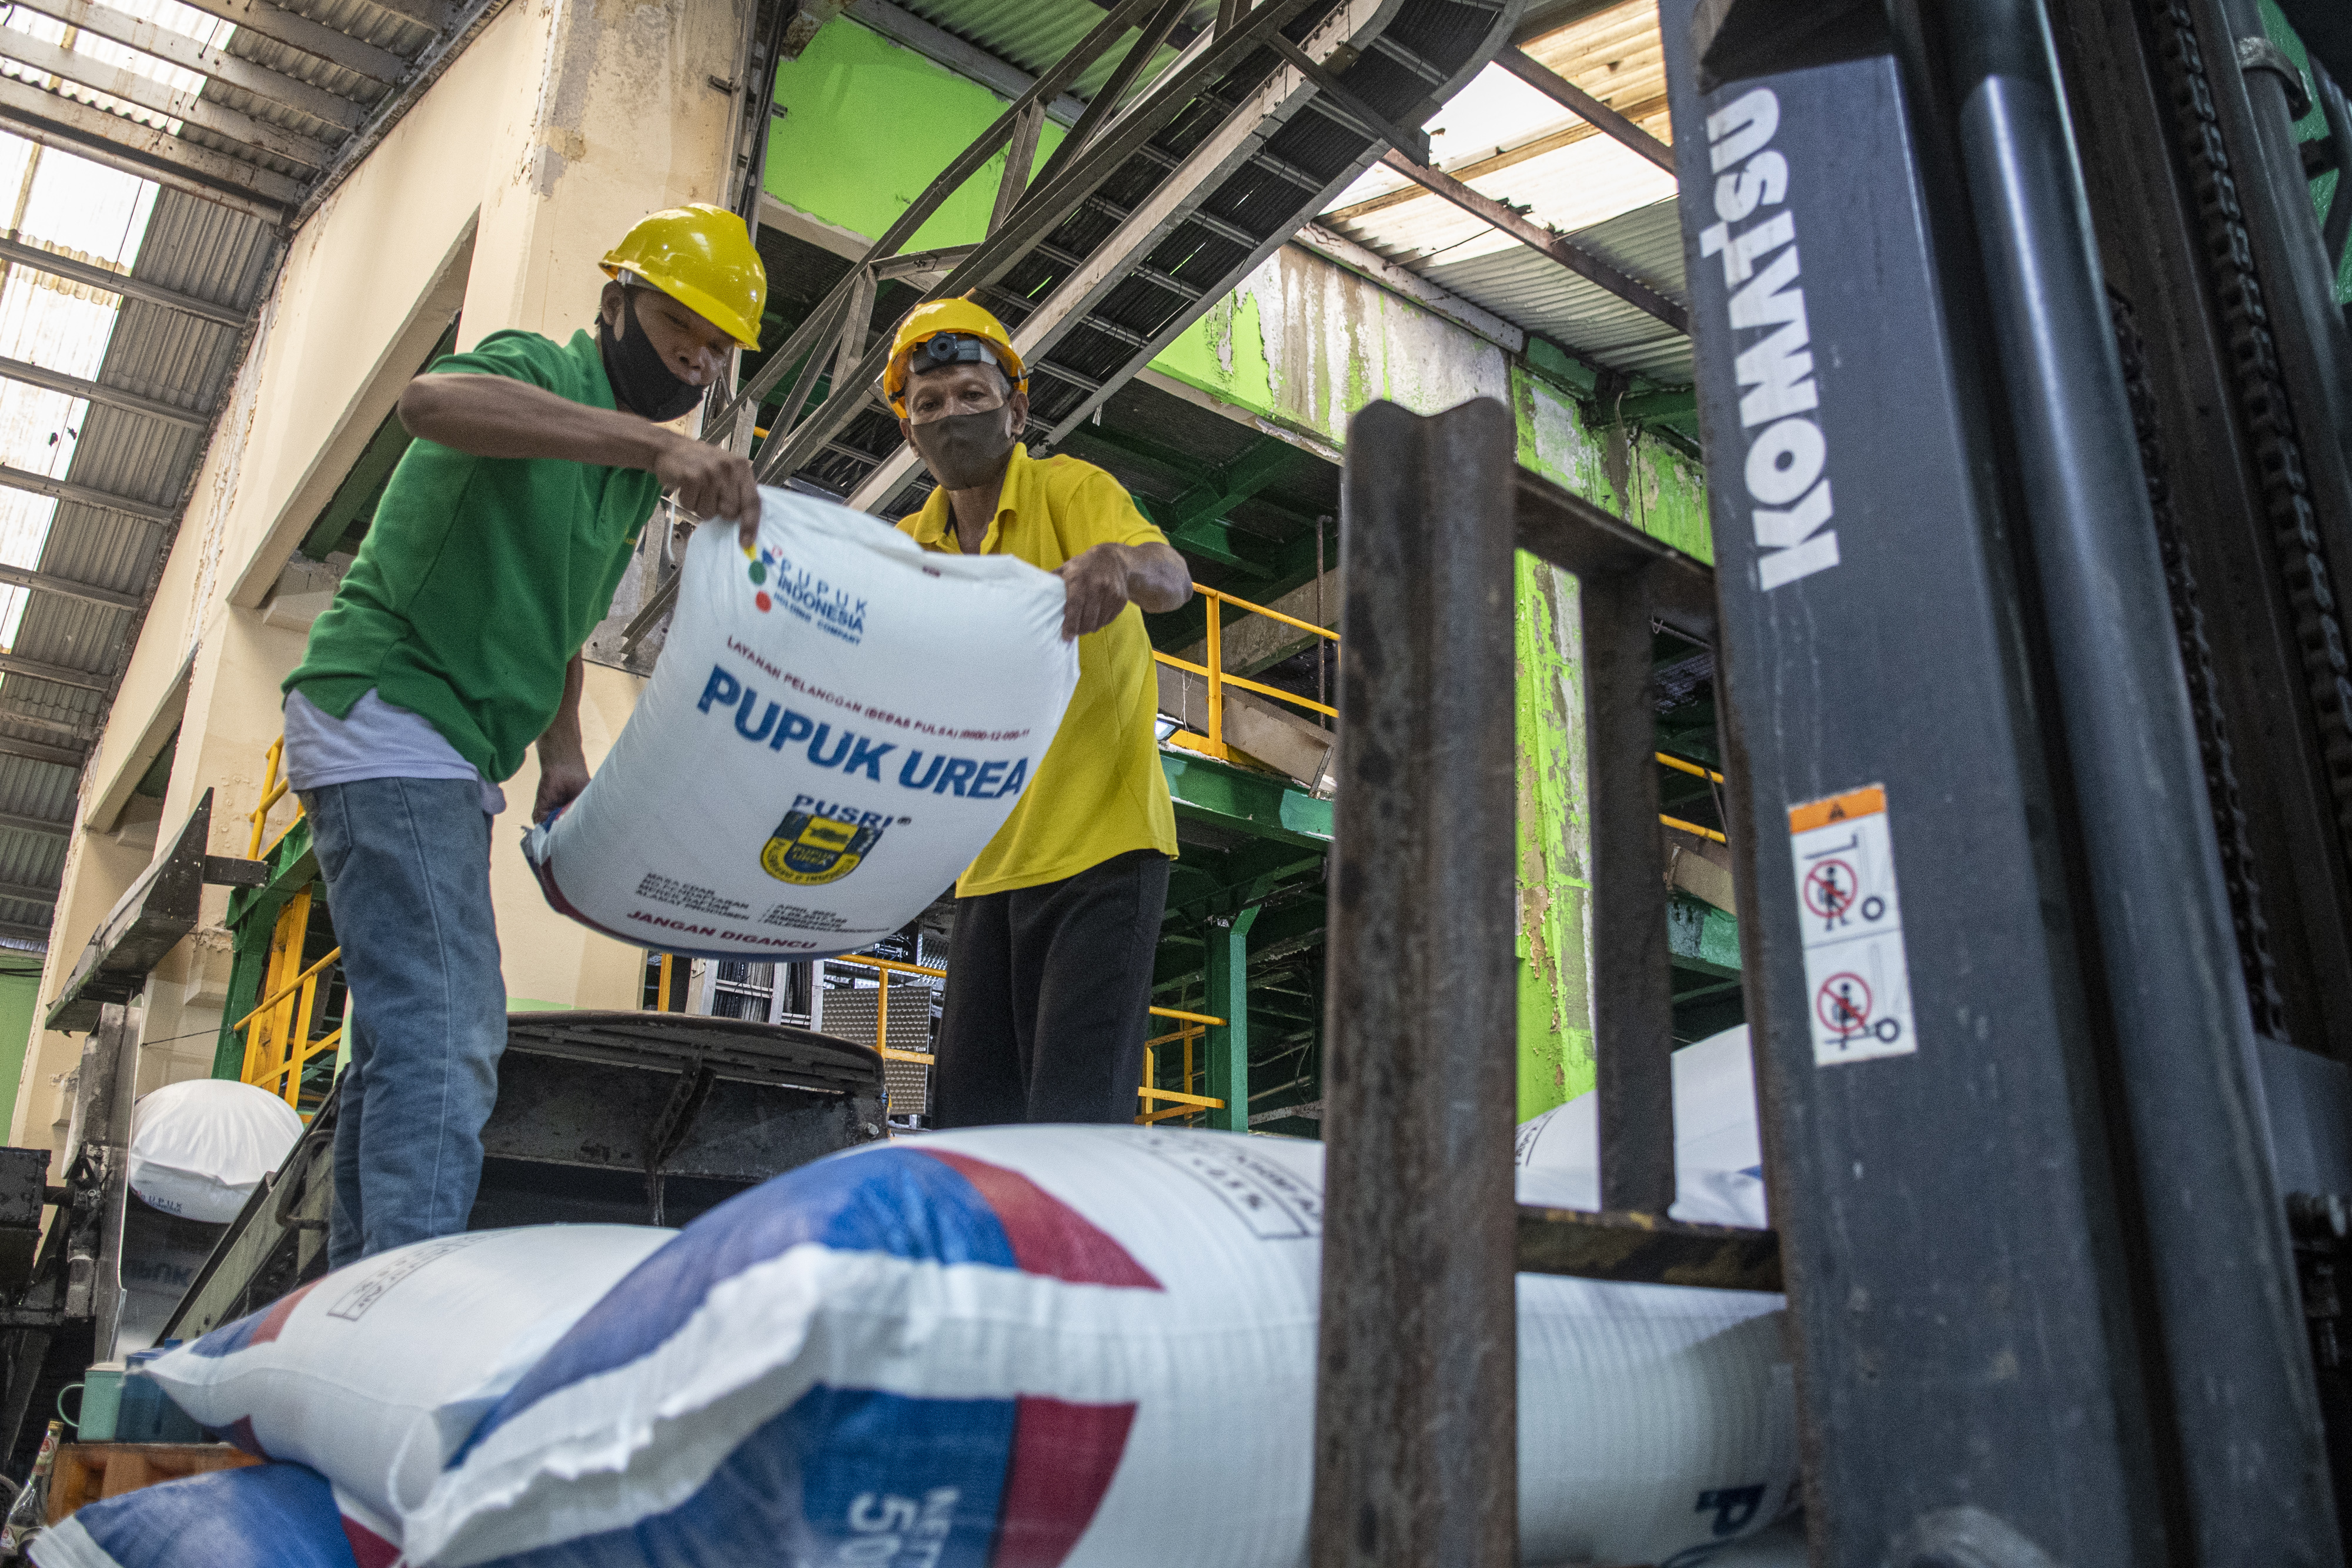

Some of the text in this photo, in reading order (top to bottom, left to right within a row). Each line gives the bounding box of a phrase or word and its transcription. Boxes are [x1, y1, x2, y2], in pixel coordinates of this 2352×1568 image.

[1699, 88, 1840, 591] KOMATSU
[777, 574, 863, 635] INDONESIA
[780, 557, 868, 618] PUPUK
[727, 634, 781, 680] LAYANAN
[784, 672, 862, 713] PELANGGAN
[696, 663, 1029, 799] PUPUK UREA
[626, 911, 817, 949] JANGAN DIGANCU
